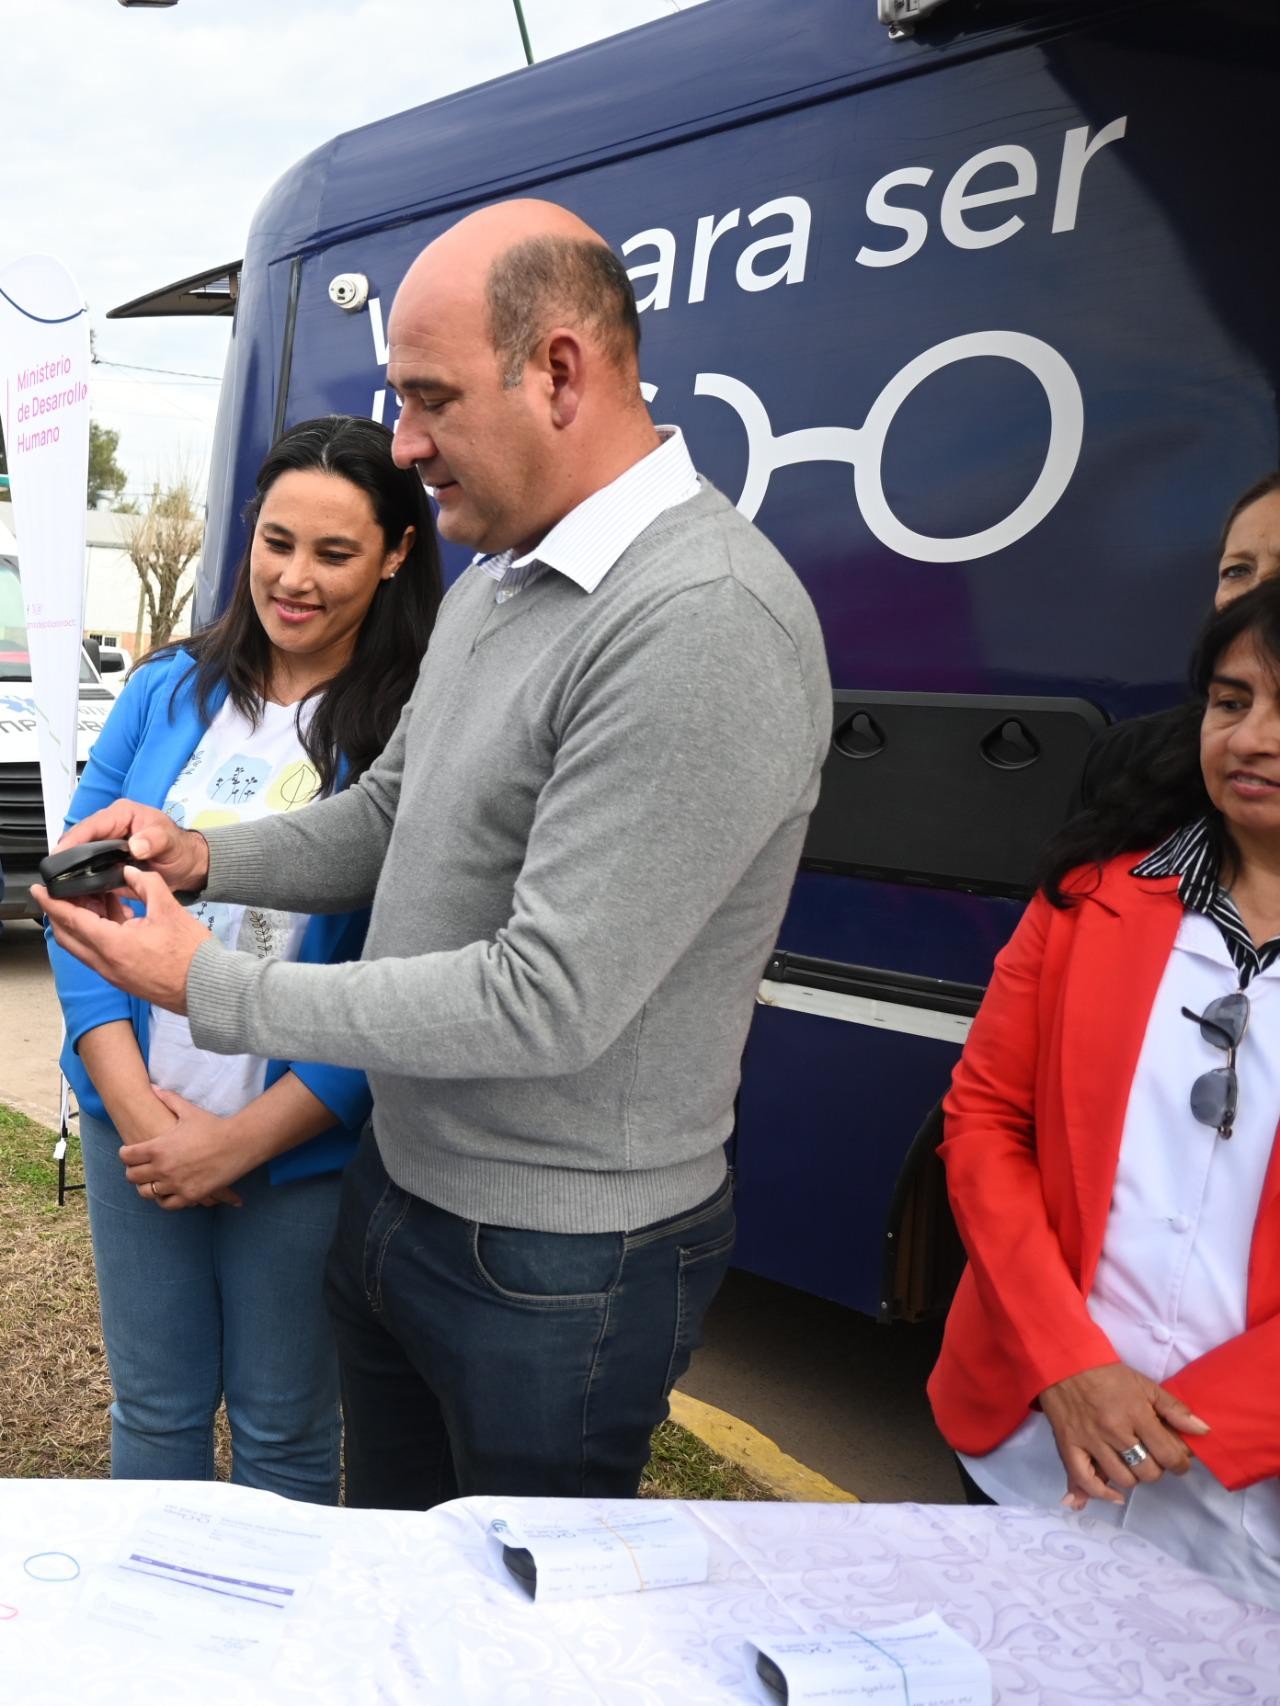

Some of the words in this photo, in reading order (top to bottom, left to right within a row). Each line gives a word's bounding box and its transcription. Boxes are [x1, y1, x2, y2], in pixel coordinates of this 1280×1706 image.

[621, 195, 812, 314] ara
[855, 115, 1128, 268] ser
[17, 354, 71, 392] Ministerio
[17, 402, 30, 423] de
[32, 381, 88, 417] Desarrollo
[17, 426, 60, 454] Humano
